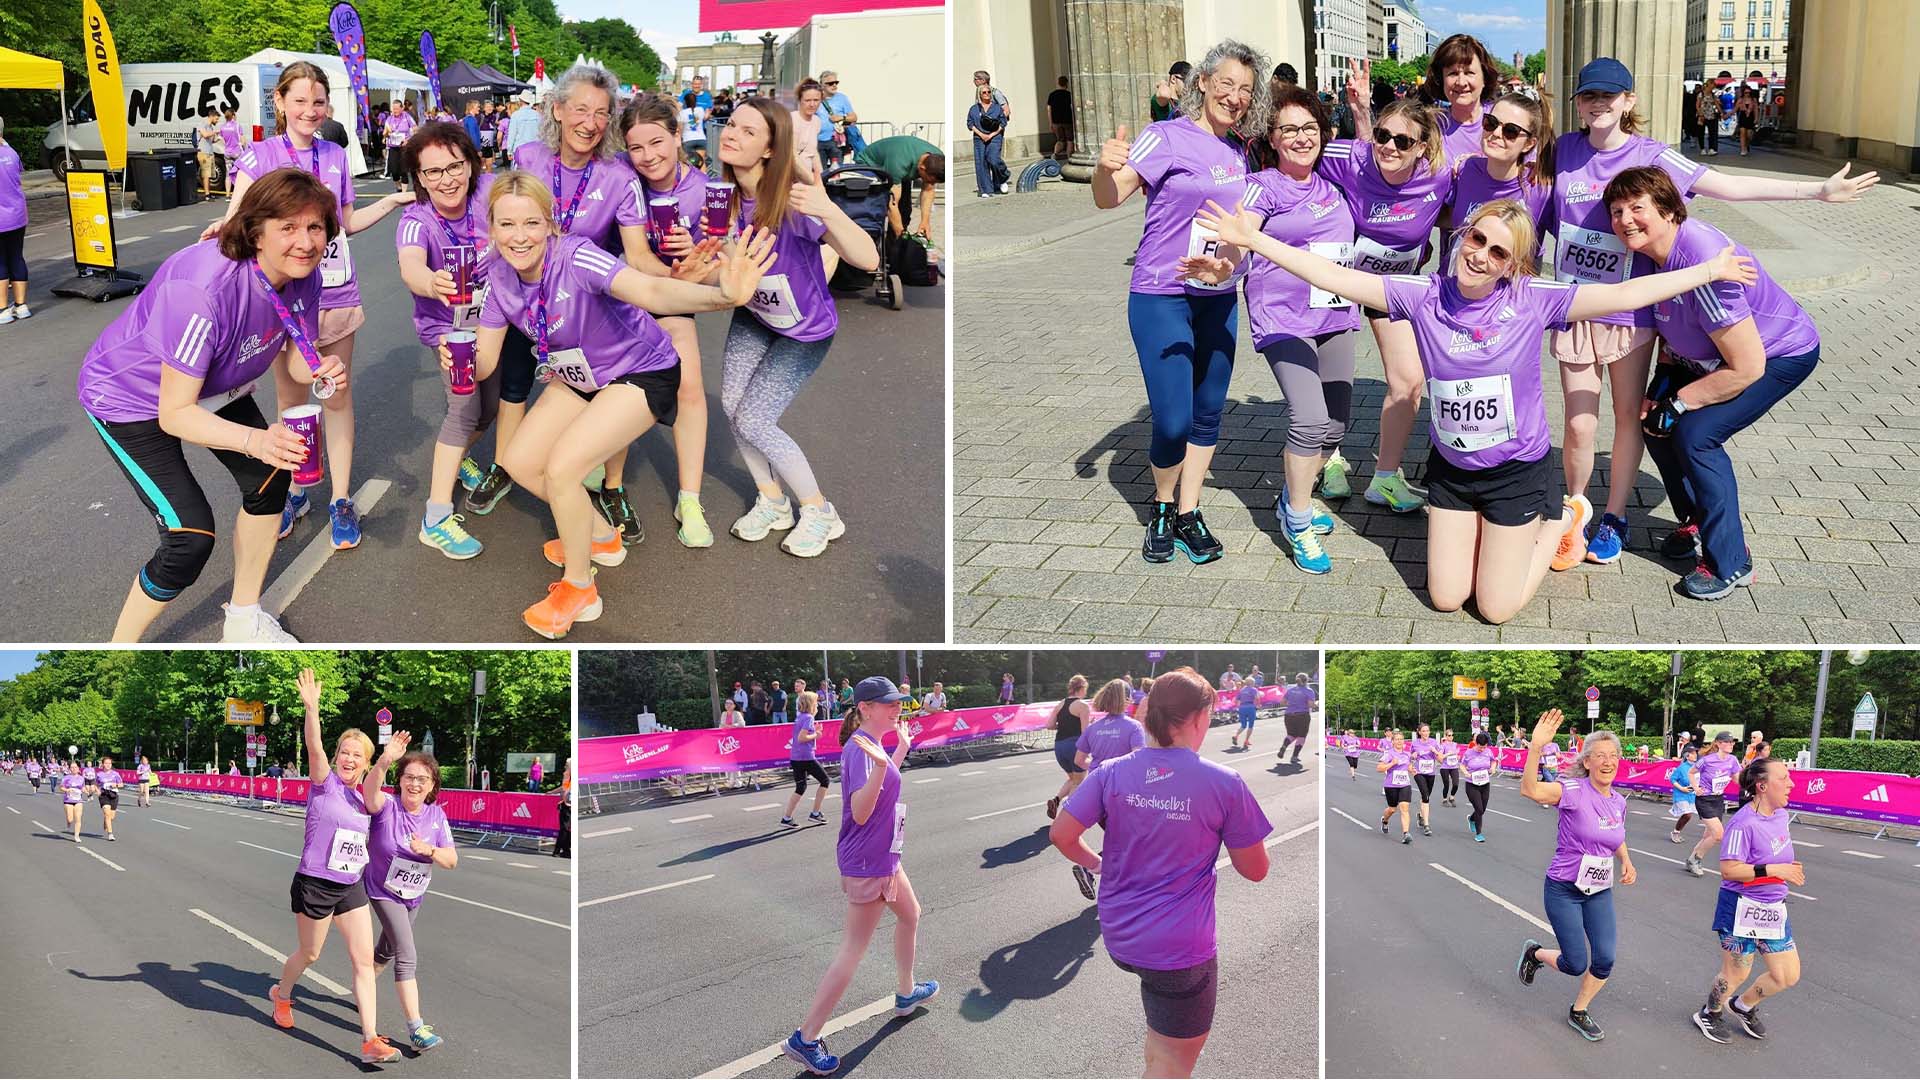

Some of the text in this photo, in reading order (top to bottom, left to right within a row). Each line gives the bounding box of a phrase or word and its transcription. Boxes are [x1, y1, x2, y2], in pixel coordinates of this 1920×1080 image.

[88, 15, 110, 76] ADAC
[128, 75, 243, 127] MILES
[1567, 182, 1588, 197] KoRo
[1368, 213, 1416, 223] FRAUENLAUF
[1370, 203, 1391, 217] KoRo
[1586, 233, 1603, 246] KoRo
[1360, 255, 1409, 273] F6840
[1565, 244, 1619, 273] F6562
[1575, 267, 1602, 281] Yvonne
[239, 334, 262, 357] KoRo
[1448, 334, 1502, 356] FRAUENLAUF
[1456, 381, 1475, 397] KoRo
[1440, 398, 1498, 421] F6165
[297, 421, 311, 431] du
[1461, 424, 1479, 432] Nina
[623, 744, 643, 759] KoRo
[718, 736, 740, 755] KoRo
[626, 744, 669, 765] FRAUENLAUF
[1807, 778, 1827, 795] KoRo
[1744, 907, 1780, 922] F6286
